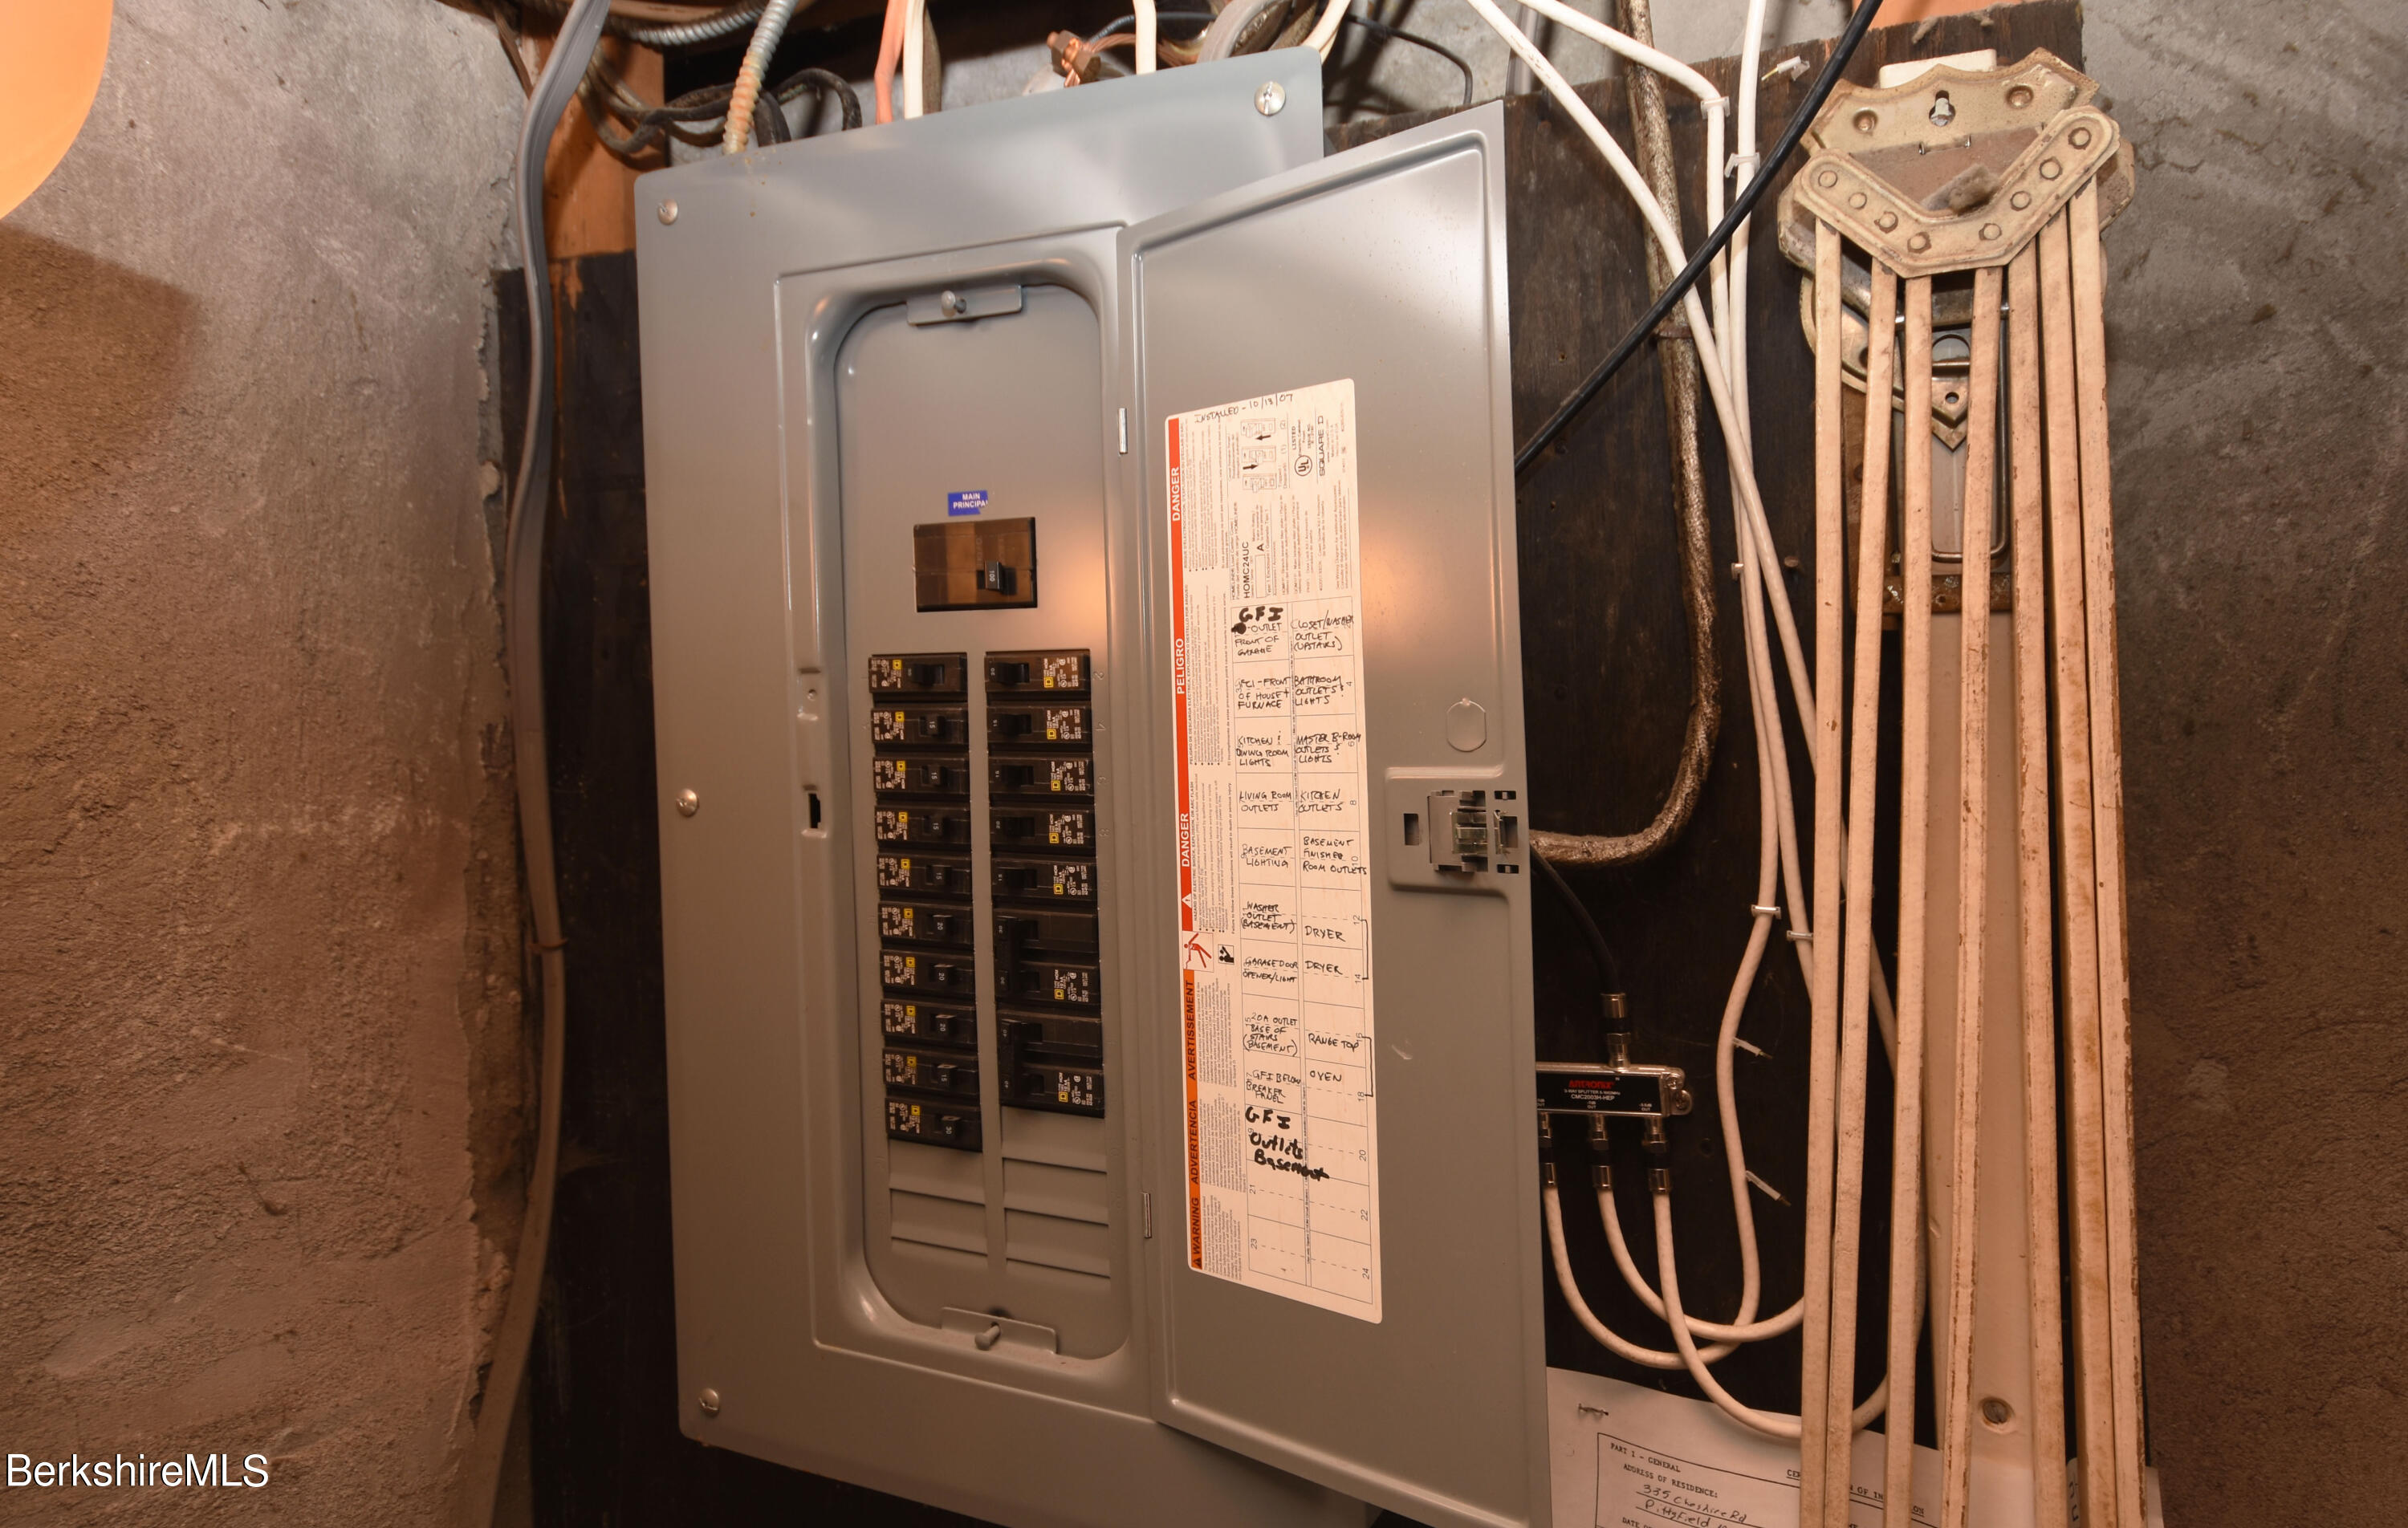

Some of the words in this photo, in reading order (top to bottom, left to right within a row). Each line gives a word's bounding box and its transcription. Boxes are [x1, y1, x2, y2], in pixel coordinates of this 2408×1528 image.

[1317, 416, 1324, 425] D
[962, 493, 981, 501] MAIN
[1171, 466, 1182, 522] DANGER
[1256, 543, 1264, 552] A
[1242, 542, 1250, 599] HOMC24UC
[1239, 606, 1283, 622] GFI
[1296, 632, 1332, 641] OUTLET
[1177, 638, 1186, 694] PELIGRO
[1263, 677, 1291, 686] FRONT
[1256, 690, 1280, 700] HOUSE
[1295, 695, 1330, 706] LIGHTS
[1238, 700, 1283, 709] FURNACE
[1239, 758, 1272, 767] LIGHTS
[1299, 754, 1332, 763] LIGHTS
[1239, 790, 1268, 802] LIVING
[1271, 790, 1291, 800] ROOM
[1241, 803, 1279, 813] OUTLETS
[1298, 802, 1343, 814] OUTLETS
[1181, 813, 1190, 868] DANGER
[1303, 836, 1355, 847] BASEMENT
[1243, 846, 1292, 856] BASEMENT
[1303, 861, 1326, 872] ROOM
[1330, 864, 1367, 876] OUTLETS
[1304, 925, 1346, 942] DRYER
[1305, 960, 1343, 975] DRYER
[1272, 1017, 1298, 1027] OUTLET
[1186, 981, 1197, 1081] AVERTISSEMENT
[1308, 1033, 1339, 1046] RANGE
[1309, 1070, 1342, 1083] OVEN
[1246, 1081, 1286, 1098] BREAKER
[1255, 1091, 1284, 1104] PANEL
[1245, 1106, 1291, 1130] GFI
[1189, 1100, 1198, 1185] ADVERTENCIA
[1359, 1150, 1367, 1161] 20
[1249, 1185, 1256, 1194] 21
[1361, 1209, 1369, 1221] 22
[1191, 1197, 1201, 1255] WARNING
[1251, 1238, 1258, 1250] 23
[1362, 1267, 1370, 1279] 24
[1610, 1443, 1628, 1454] PART
[1648, 1457, 1681, 1473] GENERAL
[1623, 1463, 1654, 1479] ADDRESS
[1658, 1475, 1667, 1483] OF
[1672, 1479, 1719, 1498] RESIDENCE:
[1673, 1496, 1727, 1517] Cheshire
[1730, 1510, 1747, 1523] Rd
